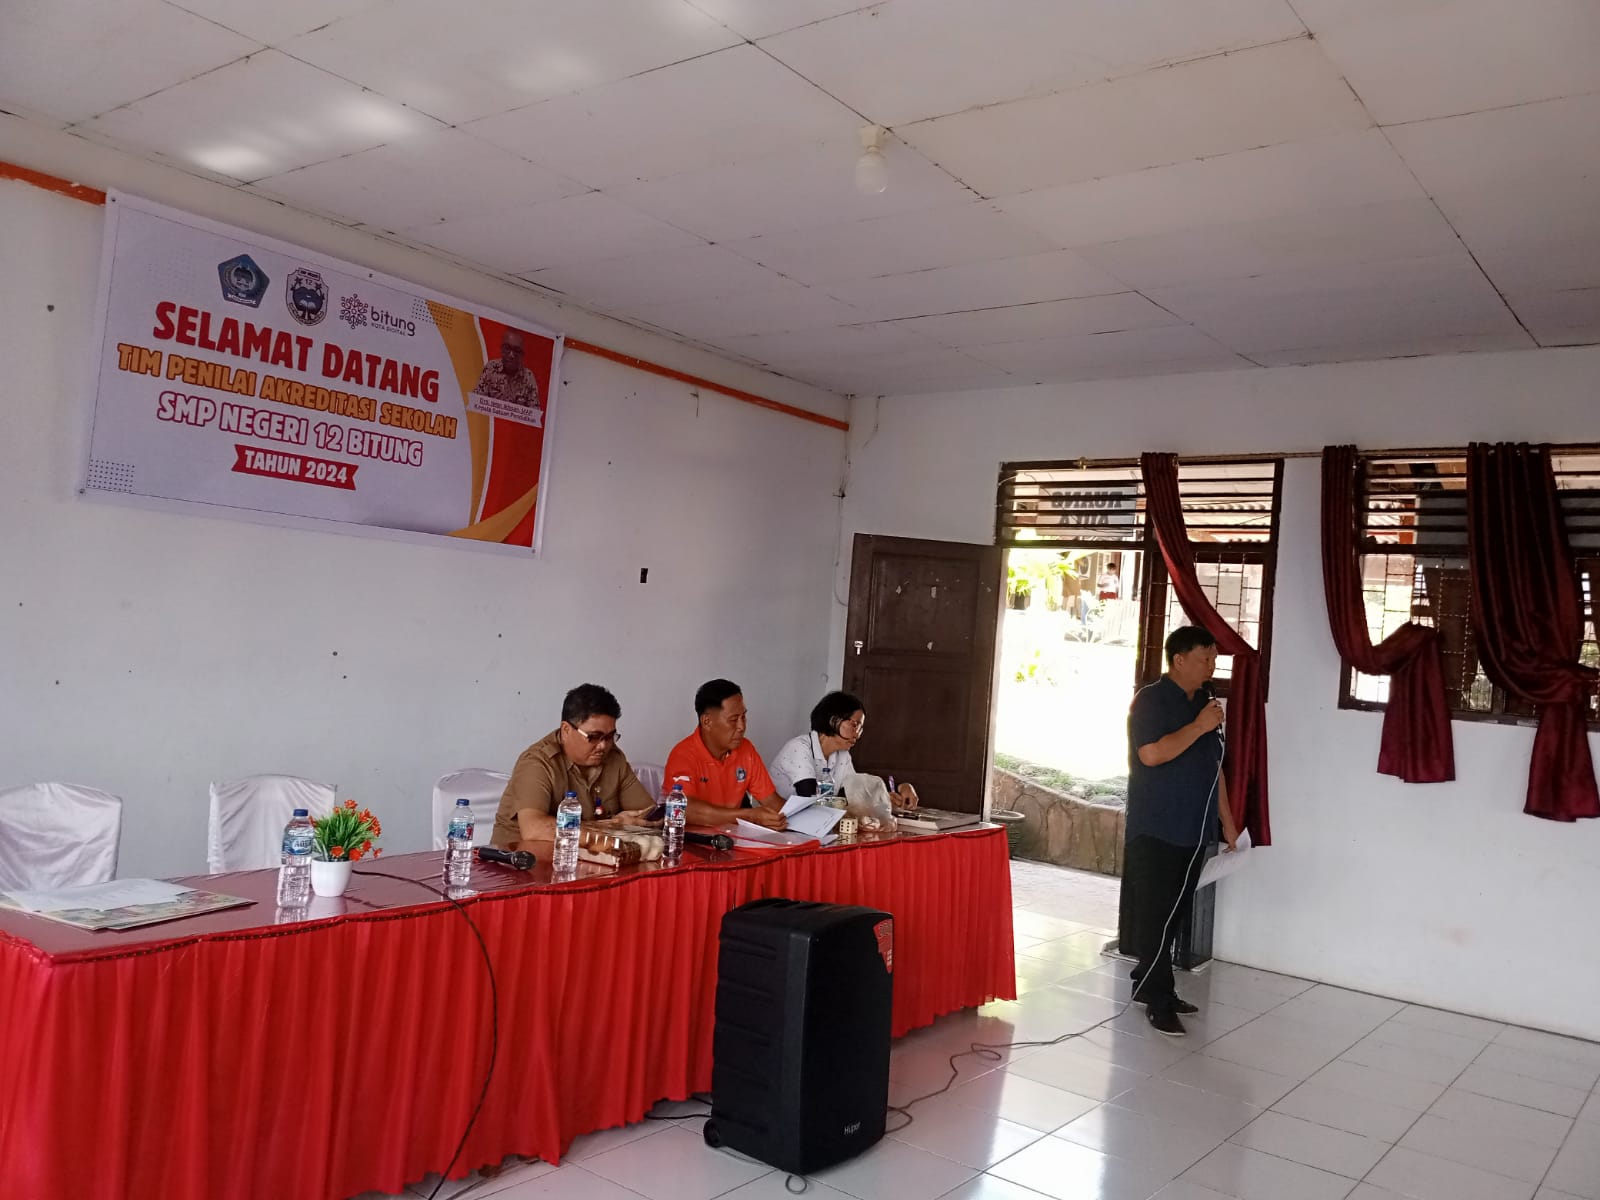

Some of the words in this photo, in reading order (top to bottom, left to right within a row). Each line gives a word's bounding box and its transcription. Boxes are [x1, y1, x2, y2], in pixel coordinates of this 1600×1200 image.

[153, 301, 313, 371] SELAMAT
[322, 343, 439, 402] DATANG
[371, 306, 416, 336] bitung
[117, 342, 162, 377] TIM
[166, 354, 257, 397] PENILAI
[260, 375, 377, 423] AKREDITASI
[379, 402, 458, 439] SEKOLAH
[157, 391, 216, 427] SMP
[219, 402, 309, 445] NEGERI
[313, 422, 343, 451] 12
[347, 428, 423, 467] BITUNG
[245, 450, 300, 476] TAHUN
[305, 461, 348, 483] 2024
